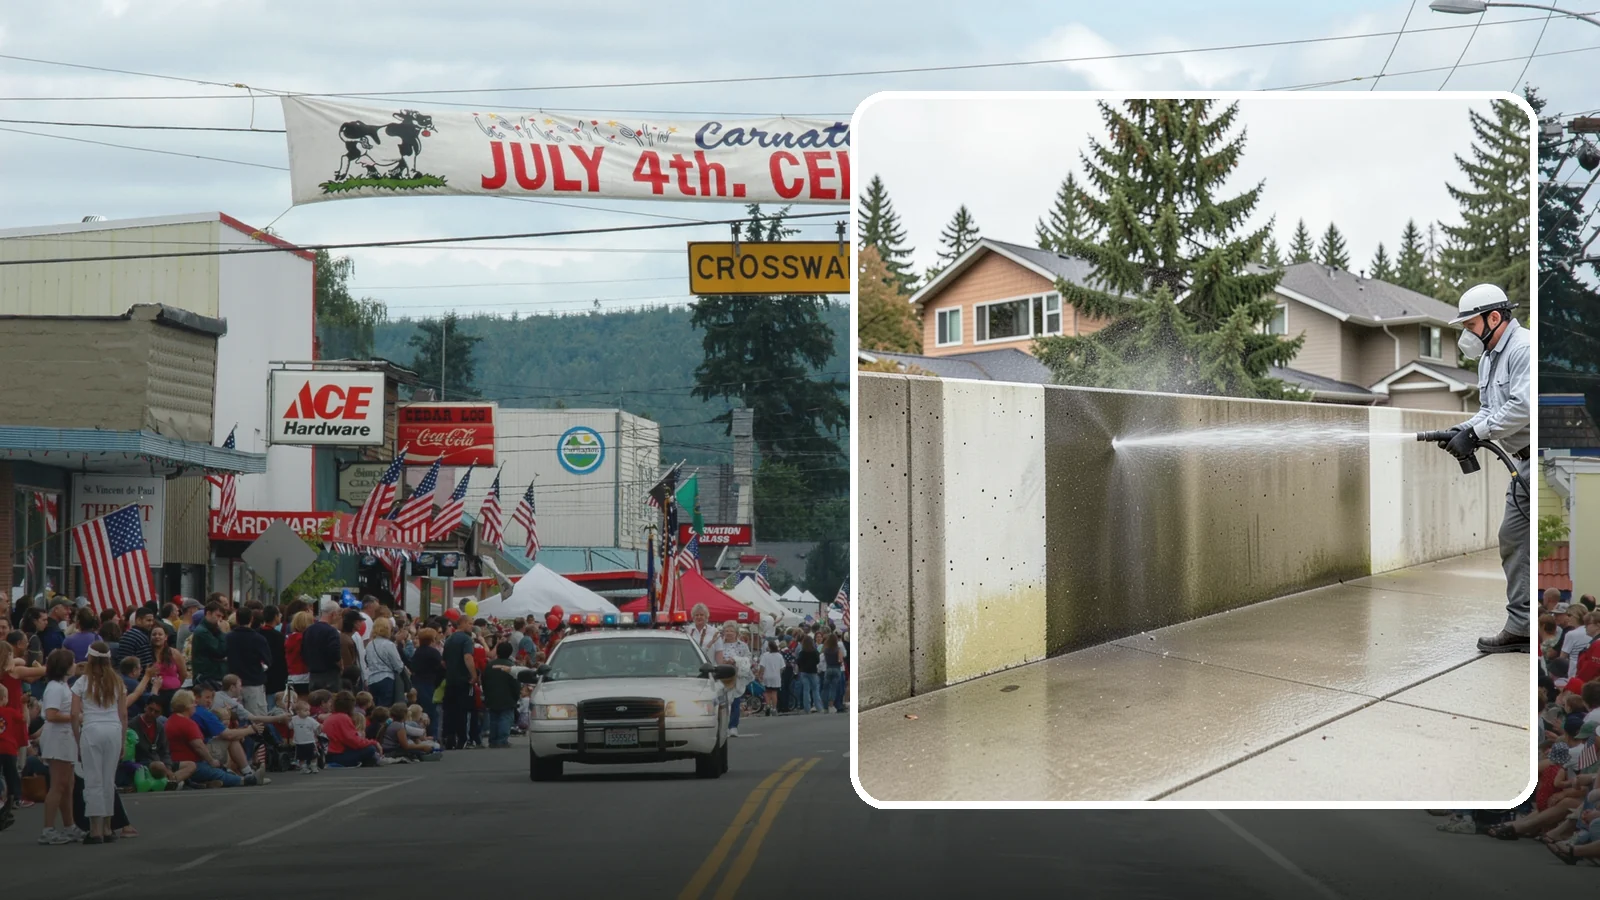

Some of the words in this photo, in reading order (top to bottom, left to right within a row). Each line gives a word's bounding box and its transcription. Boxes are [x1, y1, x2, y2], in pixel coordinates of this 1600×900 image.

[481, 141, 605, 192] JULY
[632, 150, 746, 197] 4th.
[697, 254, 850, 280] CROSSWA
[283, 380, 373, 420] ACE
[405, 409, 452, 422] CEDAR
[461, 409, 485, 422] LOG
[283, 421, 371, 436] Hardware
[95, 485, 124, 494] Vincent
[126, 486, 136, 494] de
[137, 486, 155, 495] Paul
[688, 526, 741, 535] CRNATION
[699, 535, 730, 543] GLASS
